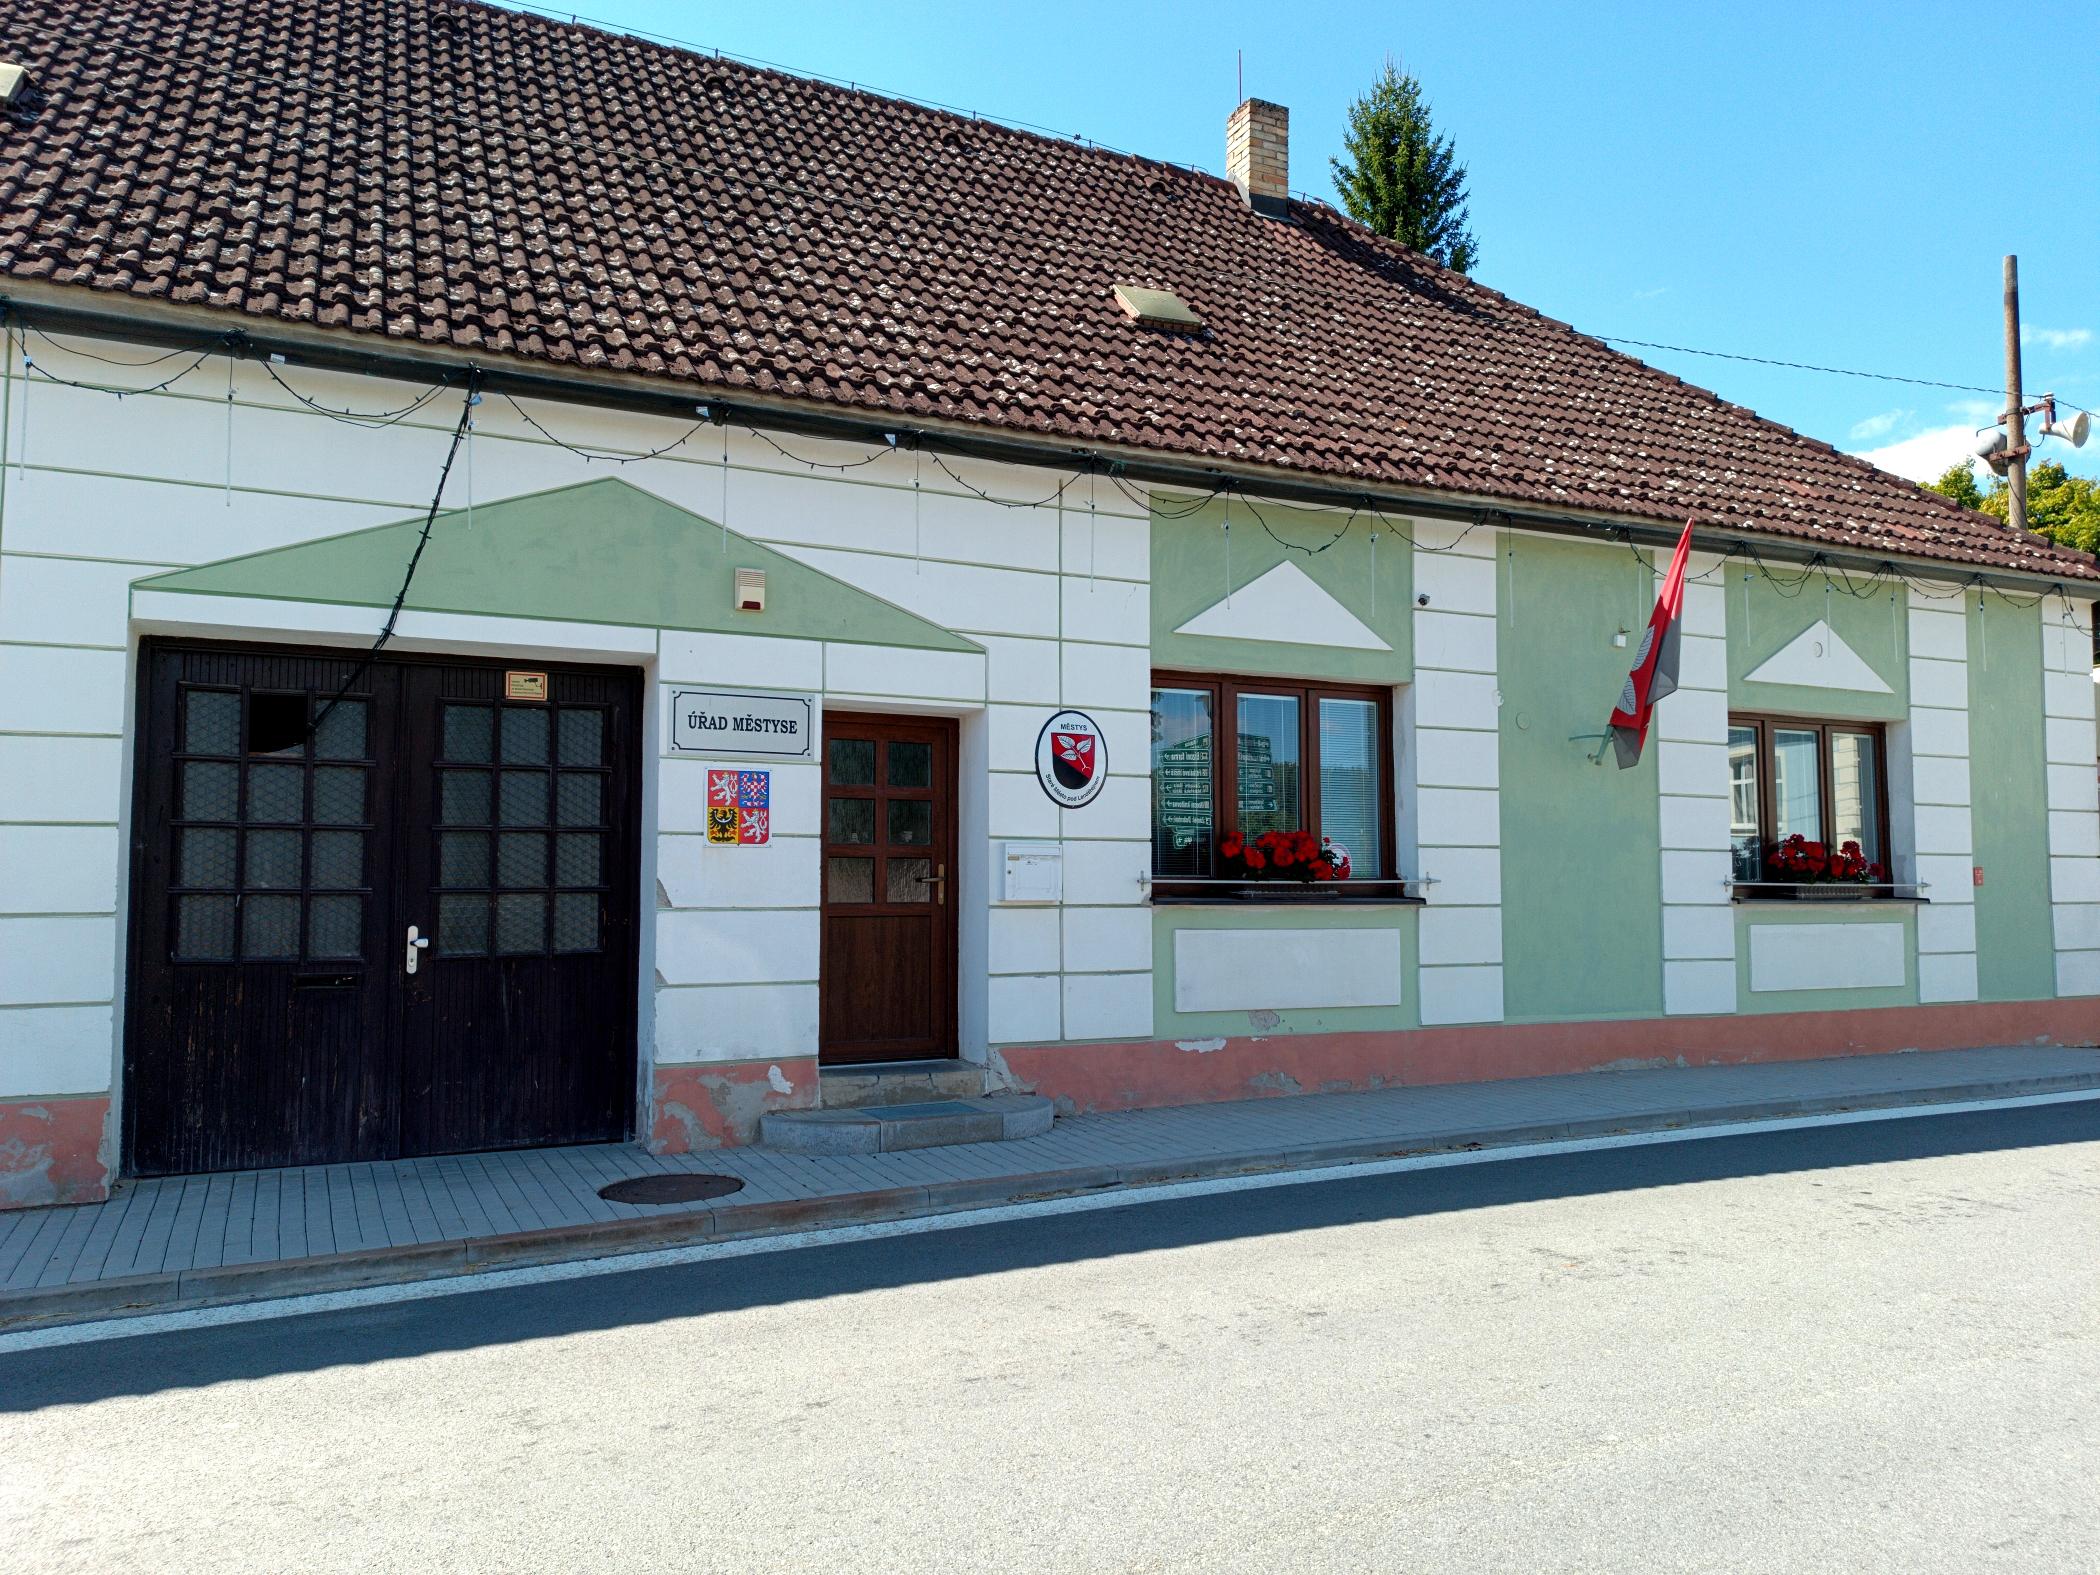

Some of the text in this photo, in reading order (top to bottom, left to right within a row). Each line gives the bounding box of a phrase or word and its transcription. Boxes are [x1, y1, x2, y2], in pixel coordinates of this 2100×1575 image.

[687, 710, 798, 735] ÚŘAD MĚSTYSE
[1060, 723, 1088, 731] MĚSTYS
